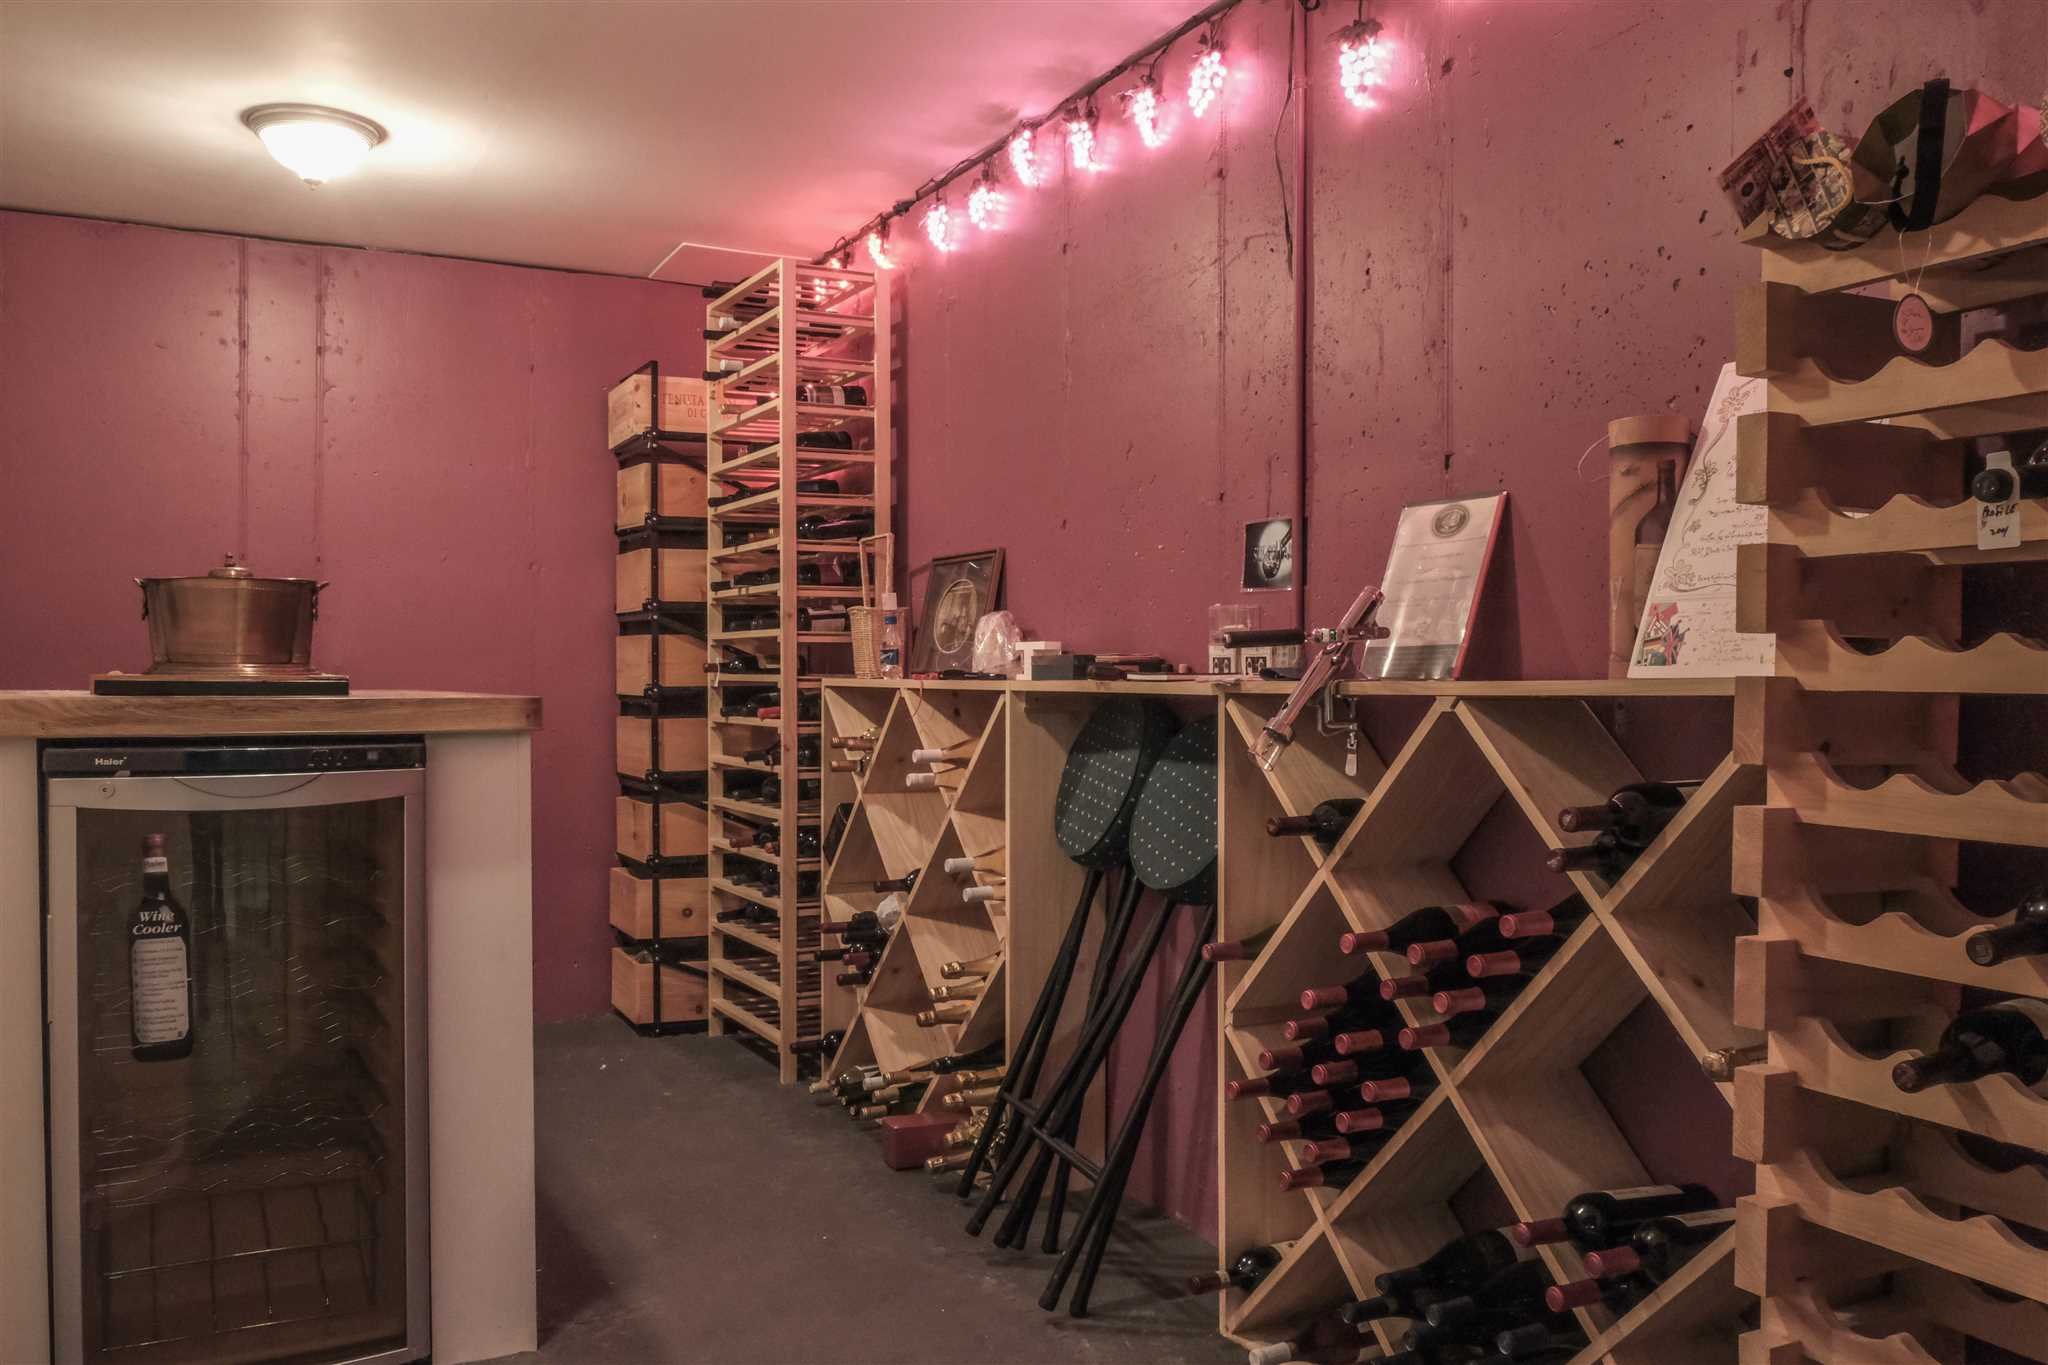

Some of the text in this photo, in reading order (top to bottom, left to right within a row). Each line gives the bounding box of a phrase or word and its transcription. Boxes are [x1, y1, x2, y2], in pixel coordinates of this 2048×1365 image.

[95, 758, 124, 769] Haier
[139, 911, 175, 922] Wine
[133, 923, 182, 935] Cooler
